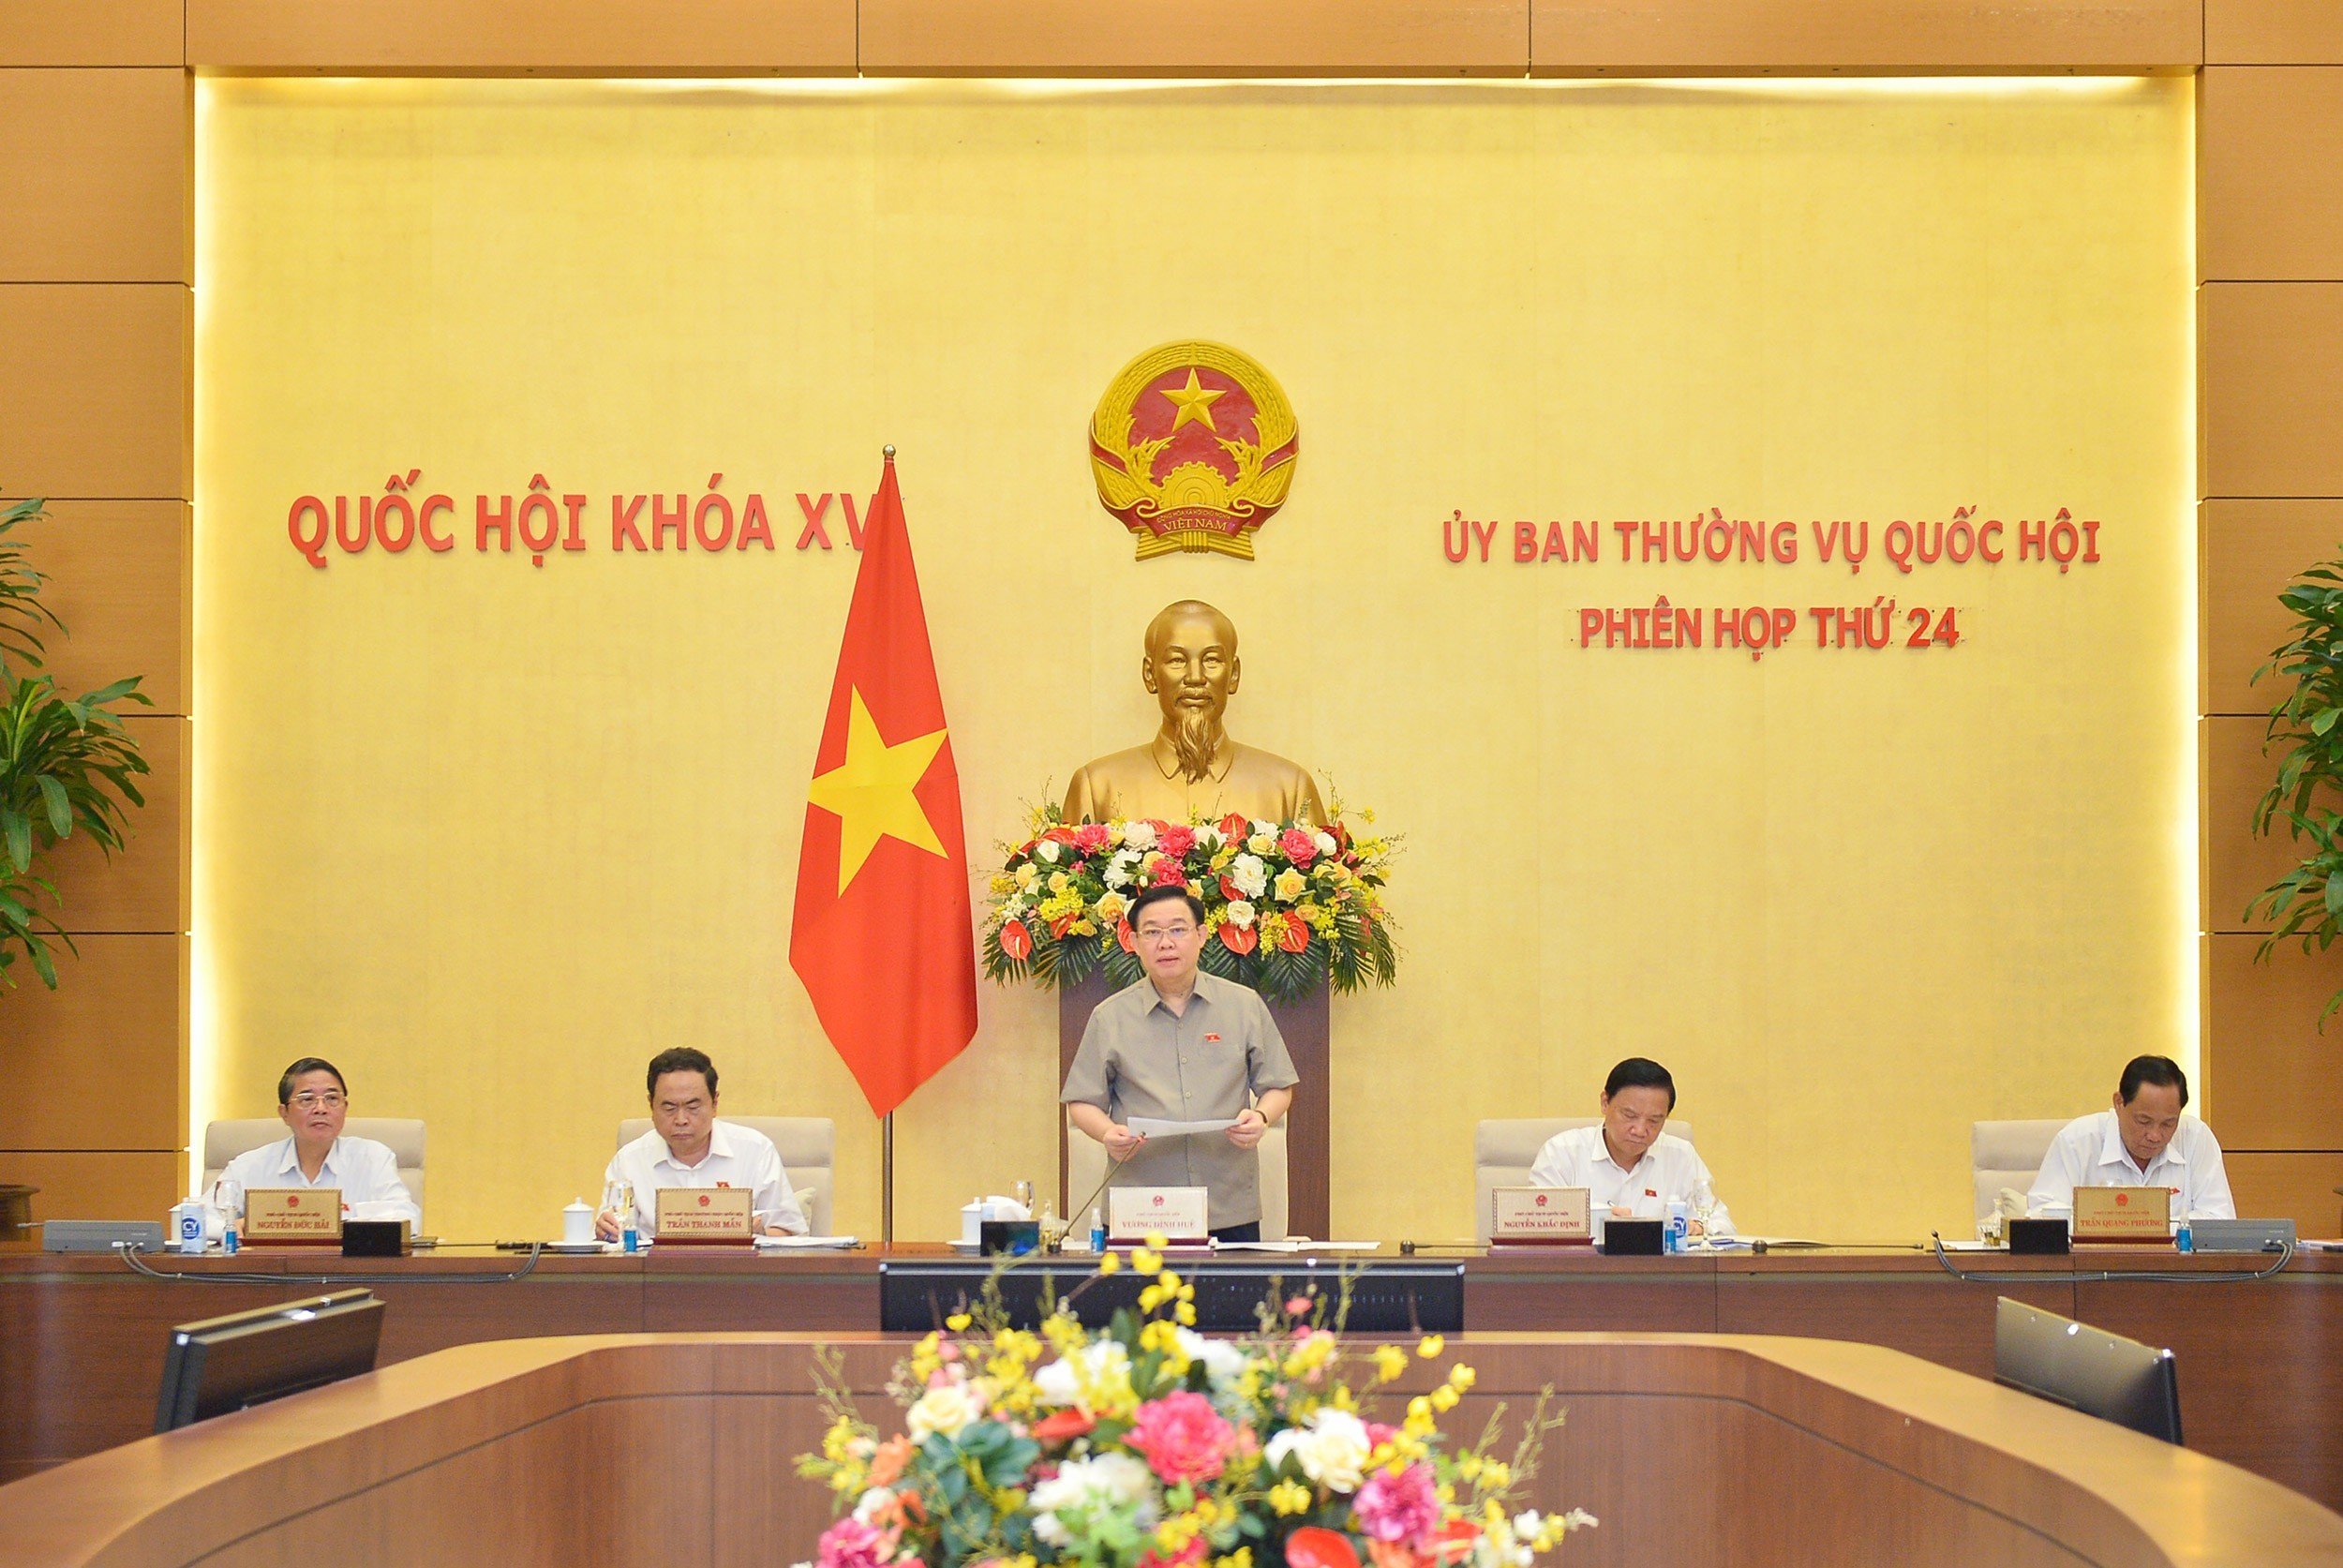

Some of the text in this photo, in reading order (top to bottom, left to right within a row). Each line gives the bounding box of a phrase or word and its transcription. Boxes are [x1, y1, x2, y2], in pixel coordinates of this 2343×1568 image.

[288, 469, 878, 568] QUỐC HỘI KHÓA XV
[1195, 518, 1227, 530] NAM
[1443, 504, 2100, 574] ỦY BAN THƯỜNG VỤ QUỐC HỘI
[1581, 595, 1960, 661] PHIÊN HỌP THỨ 24
